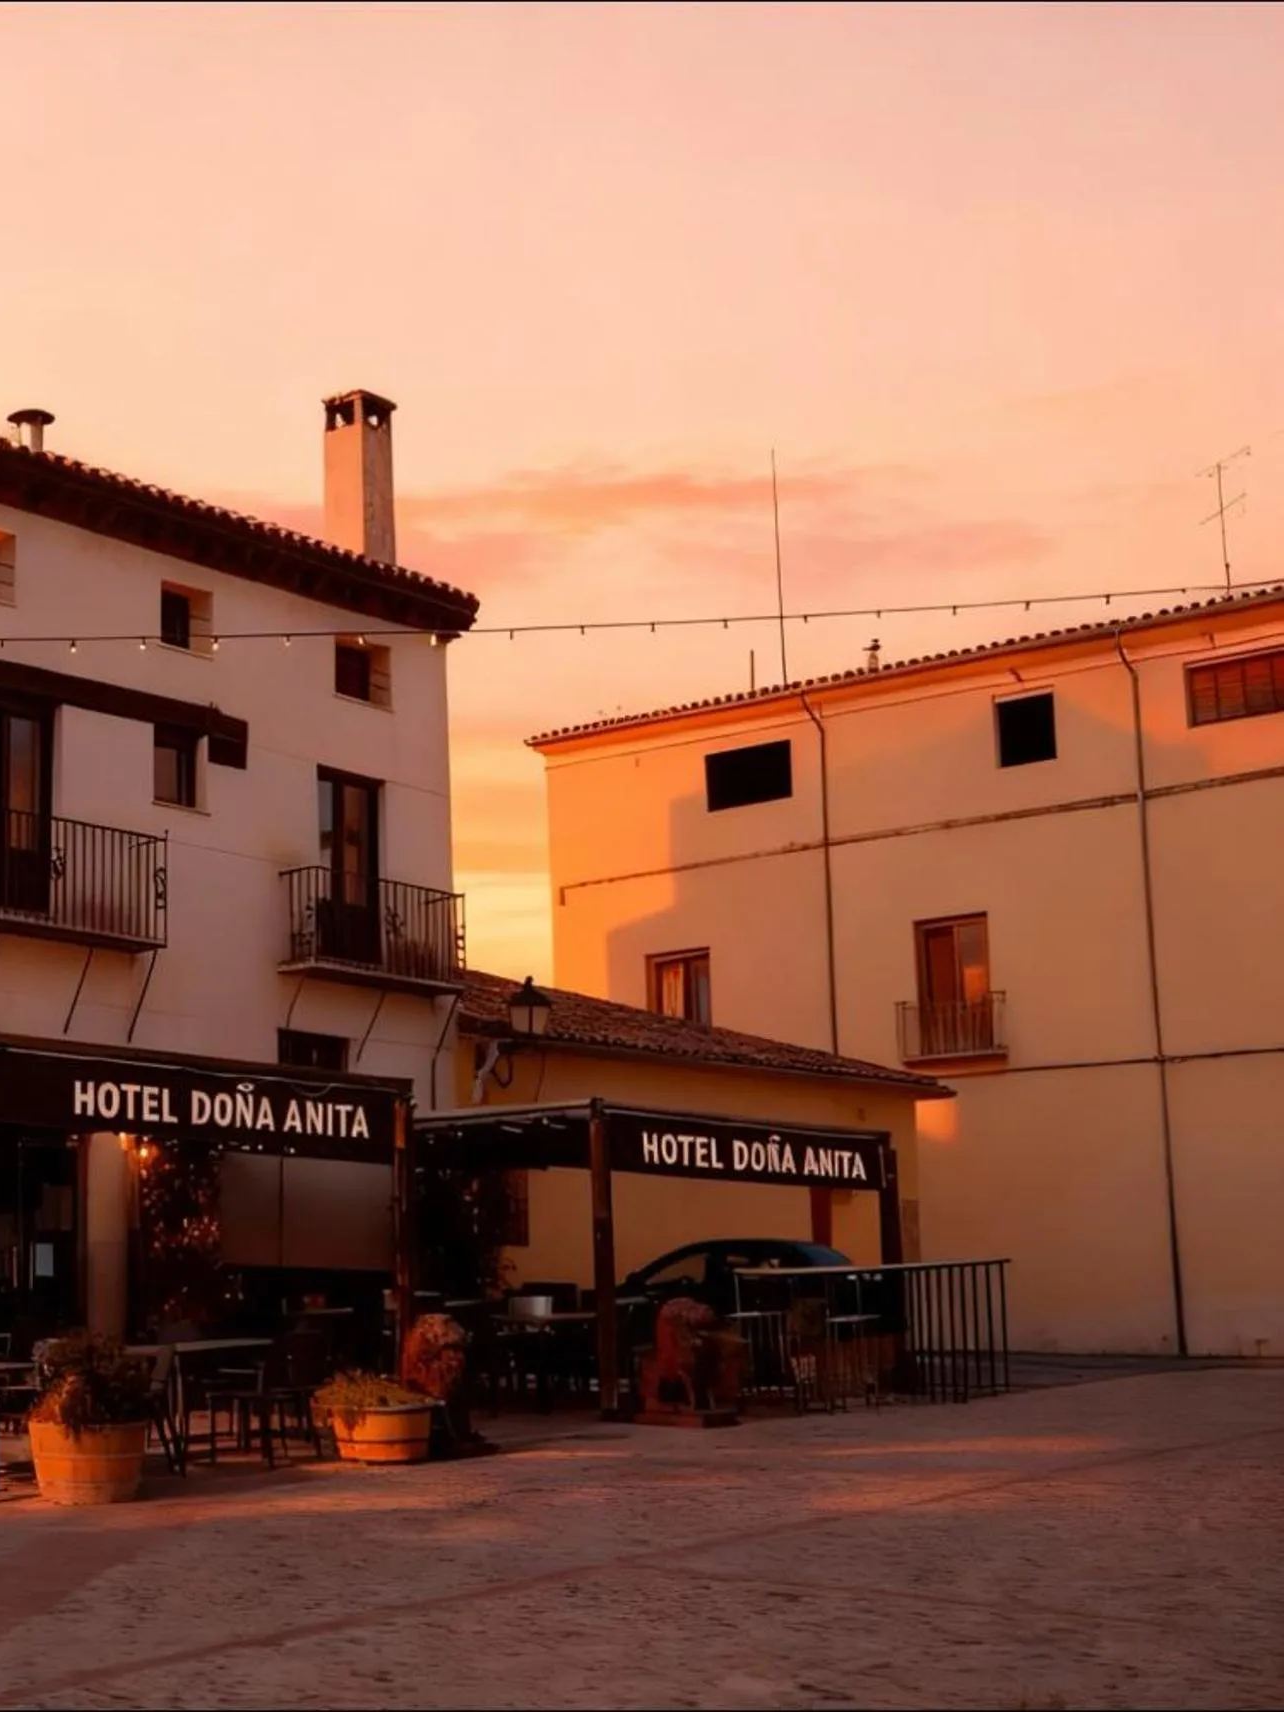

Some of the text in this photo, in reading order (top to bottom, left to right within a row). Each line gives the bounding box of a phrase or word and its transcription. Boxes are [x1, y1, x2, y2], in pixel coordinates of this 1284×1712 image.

[74, 1080, 371, 1139] HOTEL DOÑA ANITA
[642, 1131, 868, 1181] HOTEL DOÑA ANITA
